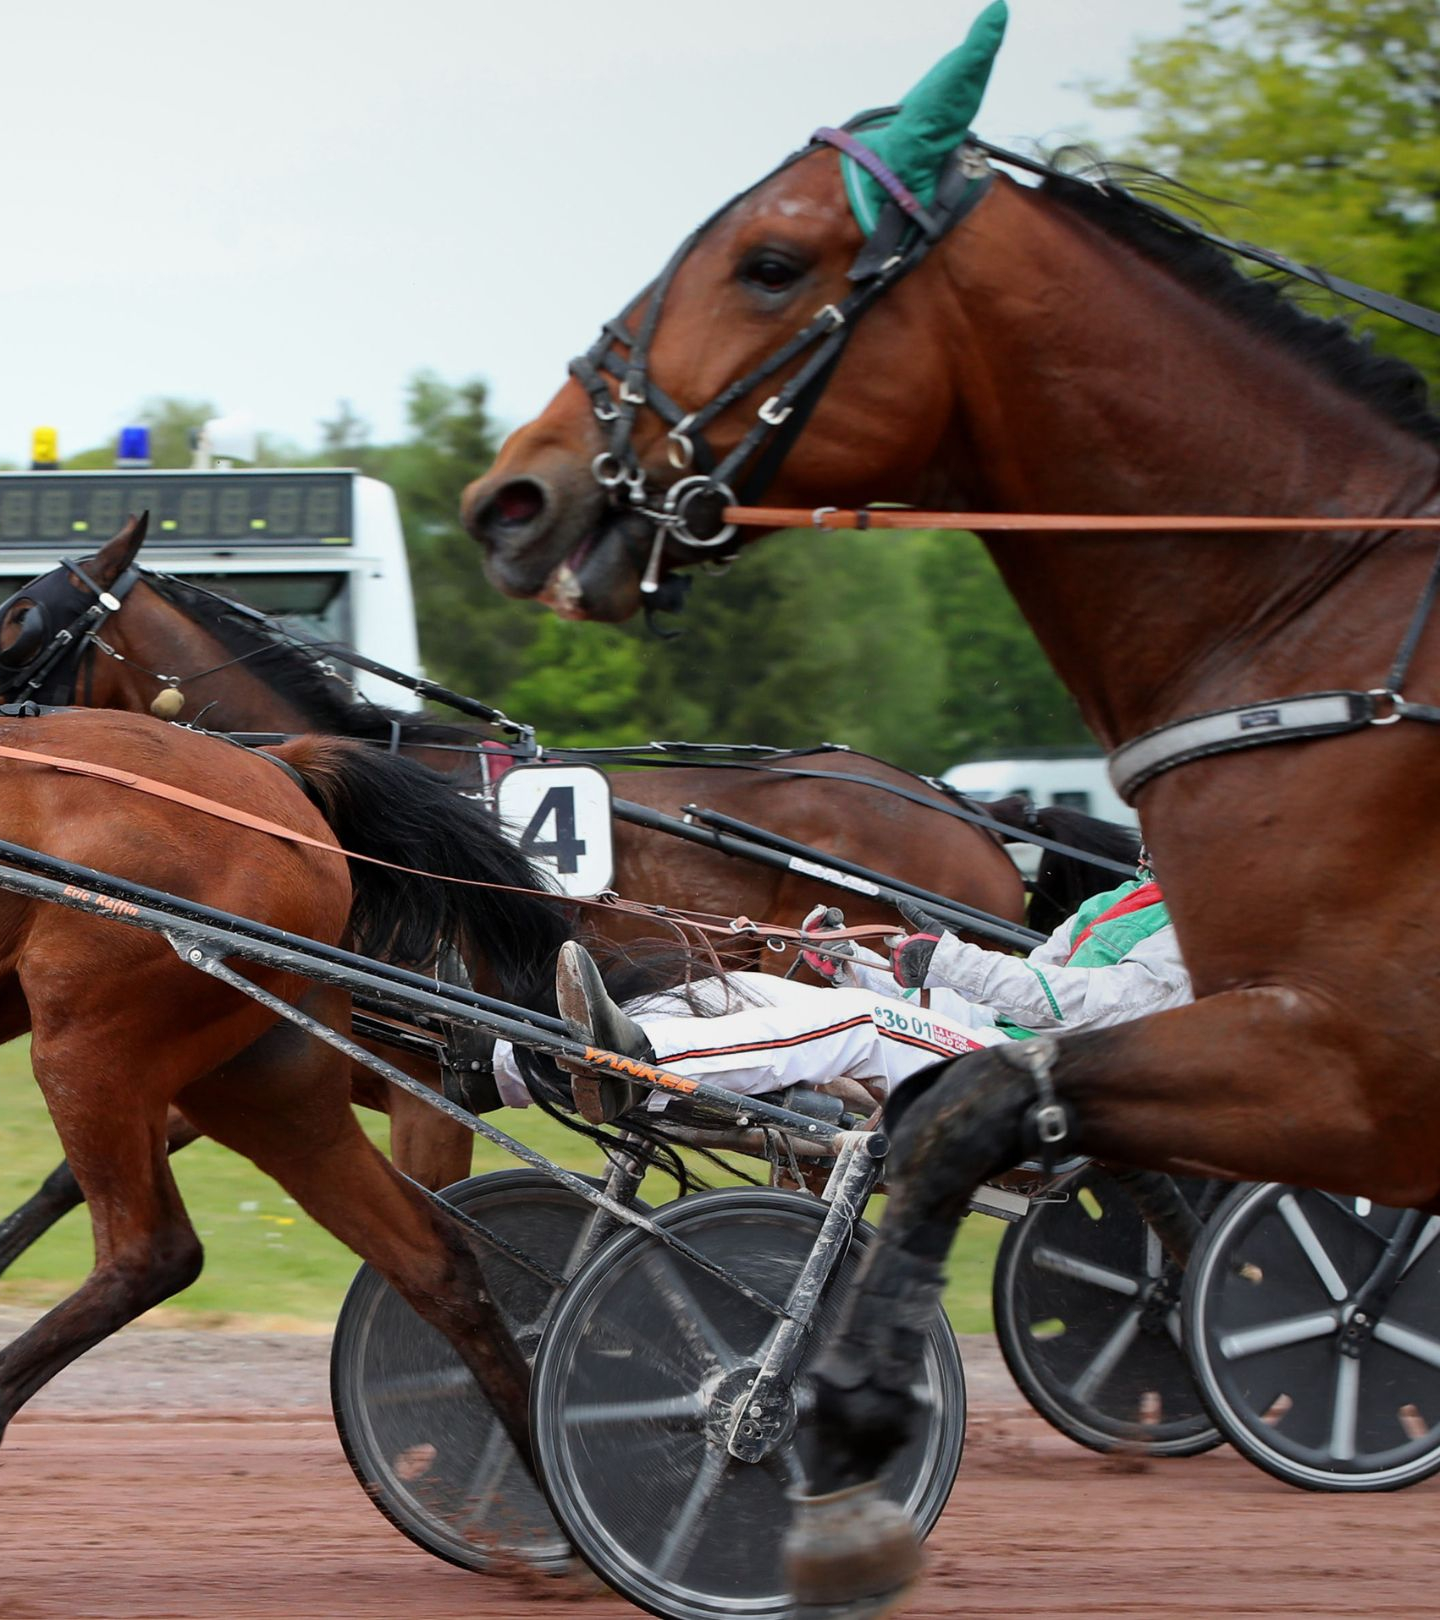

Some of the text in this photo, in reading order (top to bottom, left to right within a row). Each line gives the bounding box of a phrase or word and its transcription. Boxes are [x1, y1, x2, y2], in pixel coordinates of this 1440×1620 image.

[519, 786, 586, 874] 4
[63, 884, 140, 916] Eric Raffin
[583, 1045, 699, 1095] YANKEE
